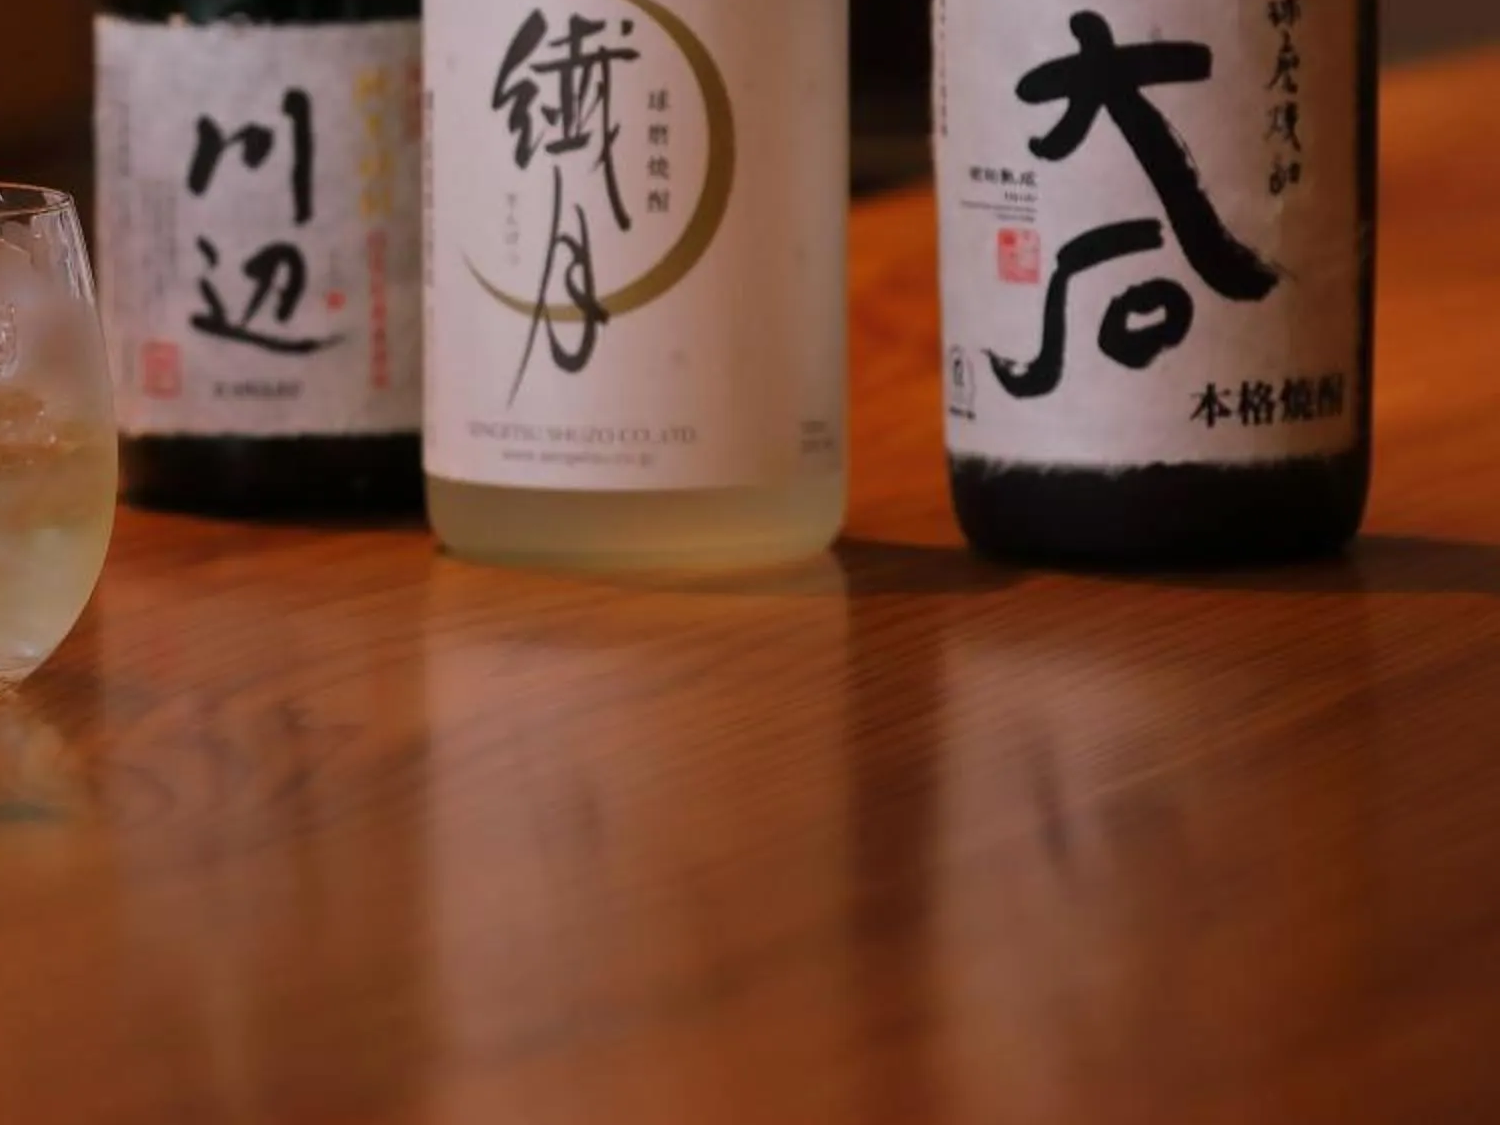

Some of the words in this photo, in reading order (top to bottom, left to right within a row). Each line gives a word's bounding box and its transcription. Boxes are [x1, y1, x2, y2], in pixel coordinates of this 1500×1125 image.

[187, 87, 348, 354] 川辺
[646, 88, 671, 213] 球磨焼酎
[982, 9, 1282, 399] 大石
[1189, 373, 1344, 428] 本格焼酎
